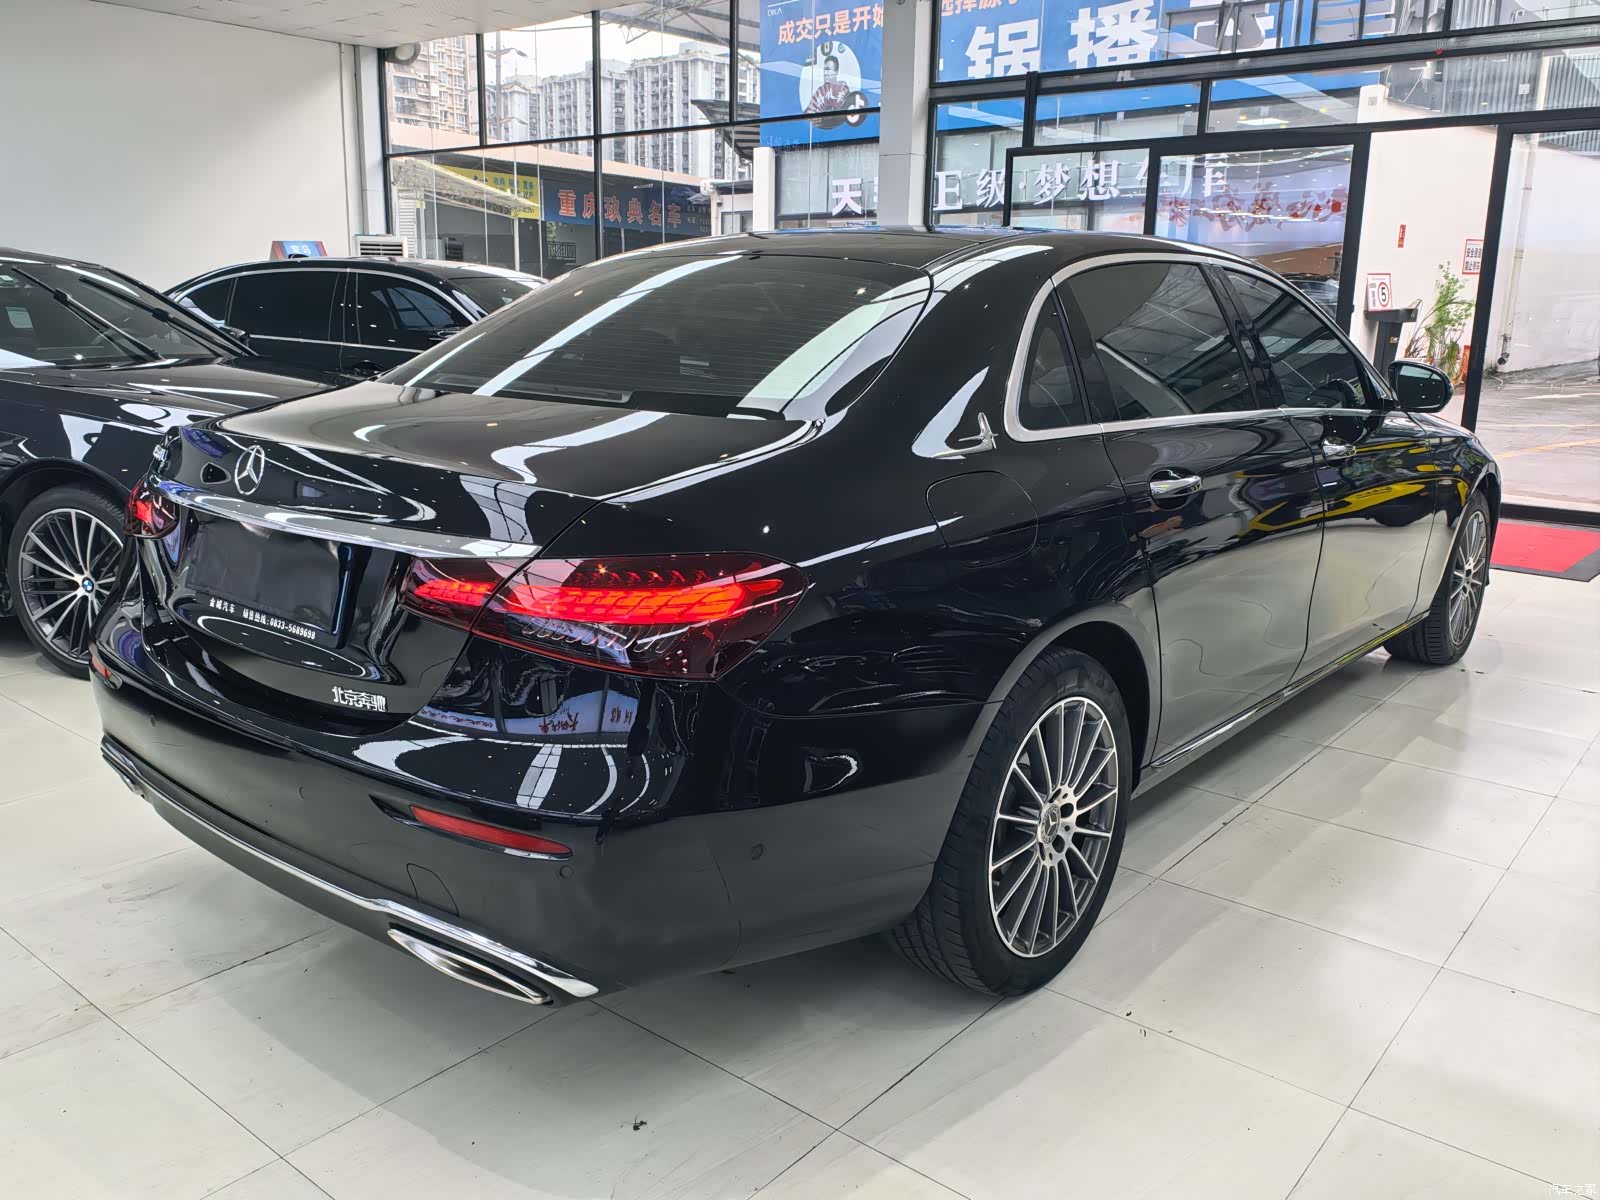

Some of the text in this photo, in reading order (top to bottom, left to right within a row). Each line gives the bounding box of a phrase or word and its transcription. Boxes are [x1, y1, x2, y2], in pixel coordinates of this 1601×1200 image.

[778, 3, 884, 46] 成交只是开始
[332, 685, 389, 713] 北京奔驰
